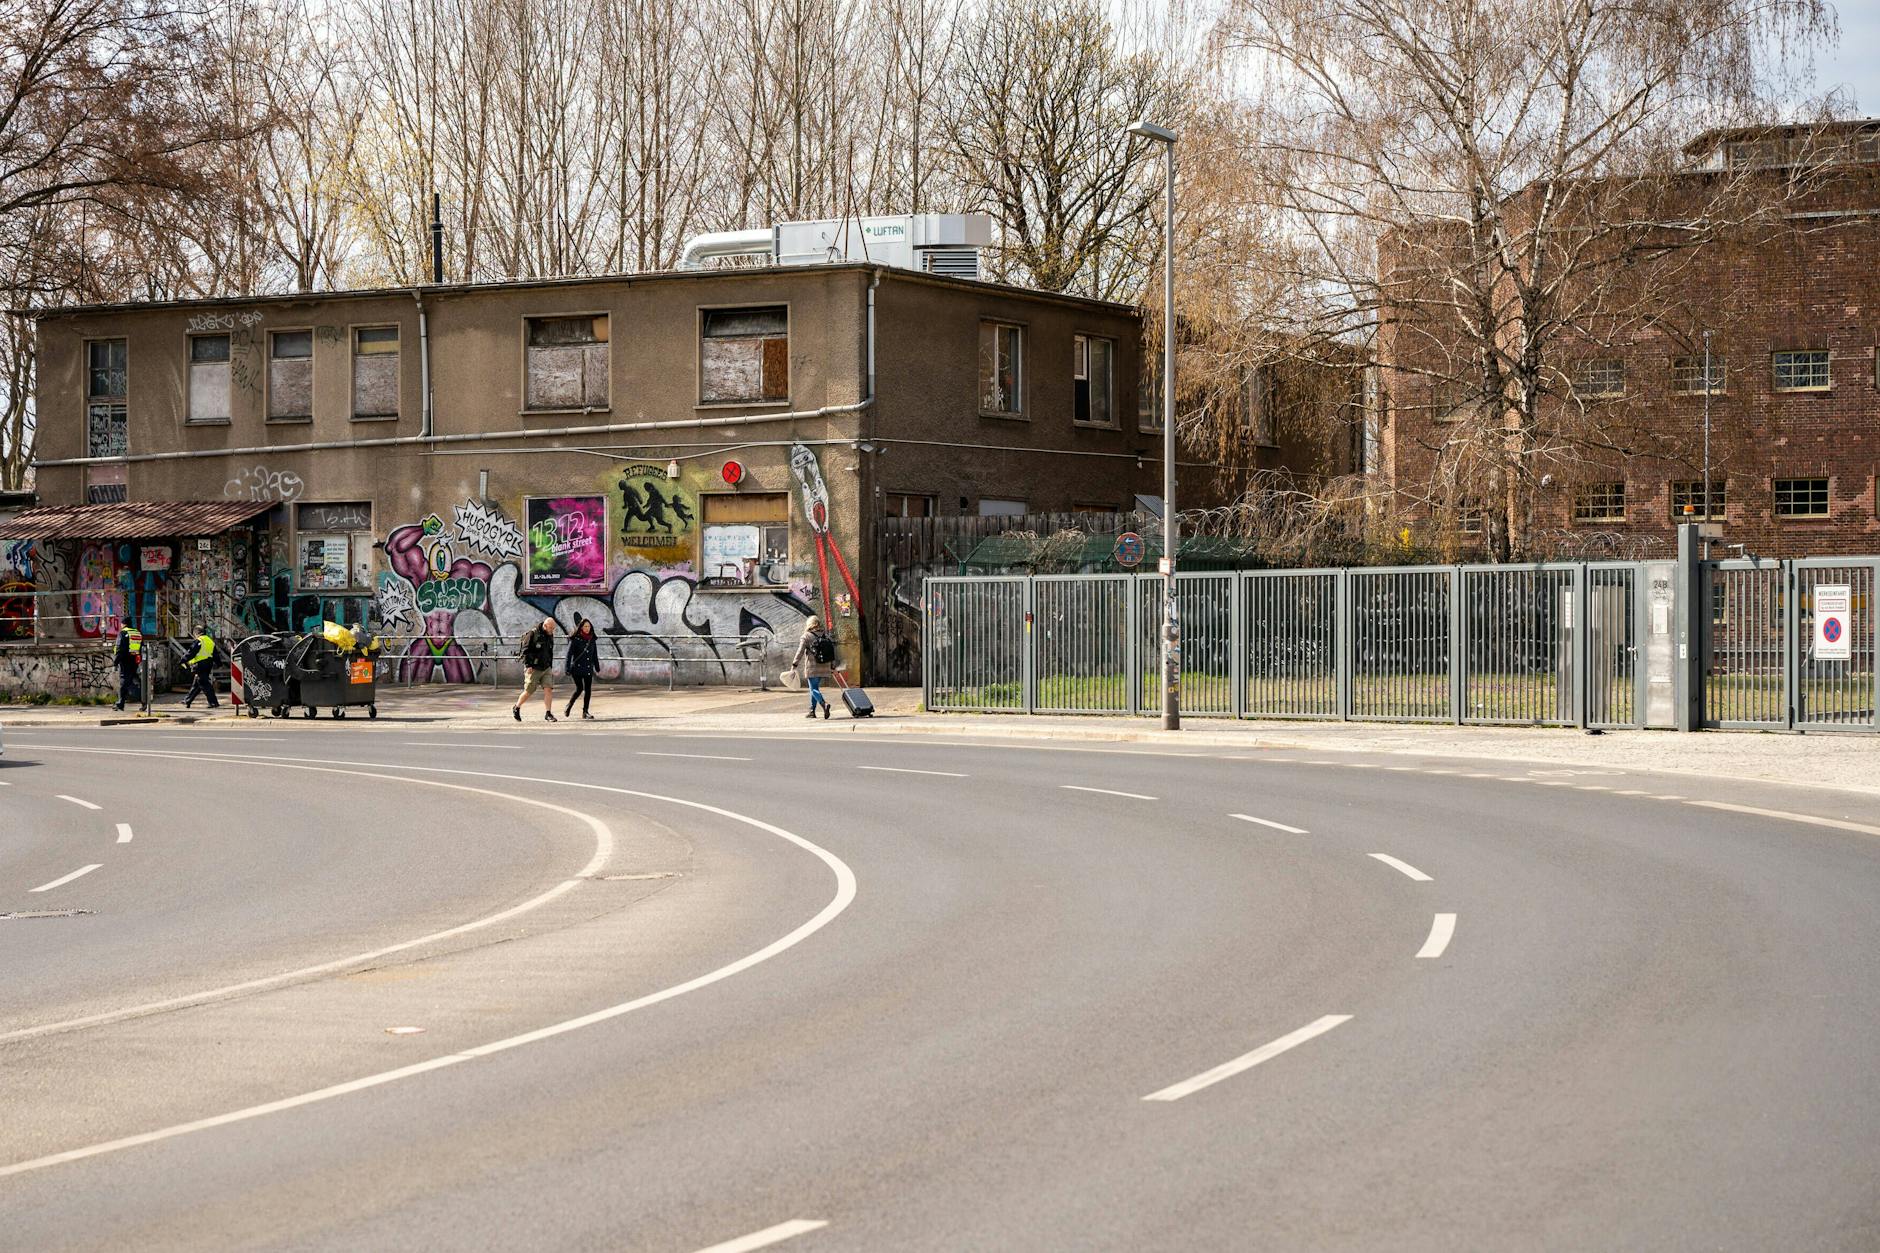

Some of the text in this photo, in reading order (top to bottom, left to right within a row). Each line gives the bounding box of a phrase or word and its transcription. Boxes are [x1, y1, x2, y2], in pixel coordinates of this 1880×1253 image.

[873, 225, 904, 236] LUFTAN
[623, 464, 668, 480] REFUGEES
[1653, 580, 1668, 589] 24B
